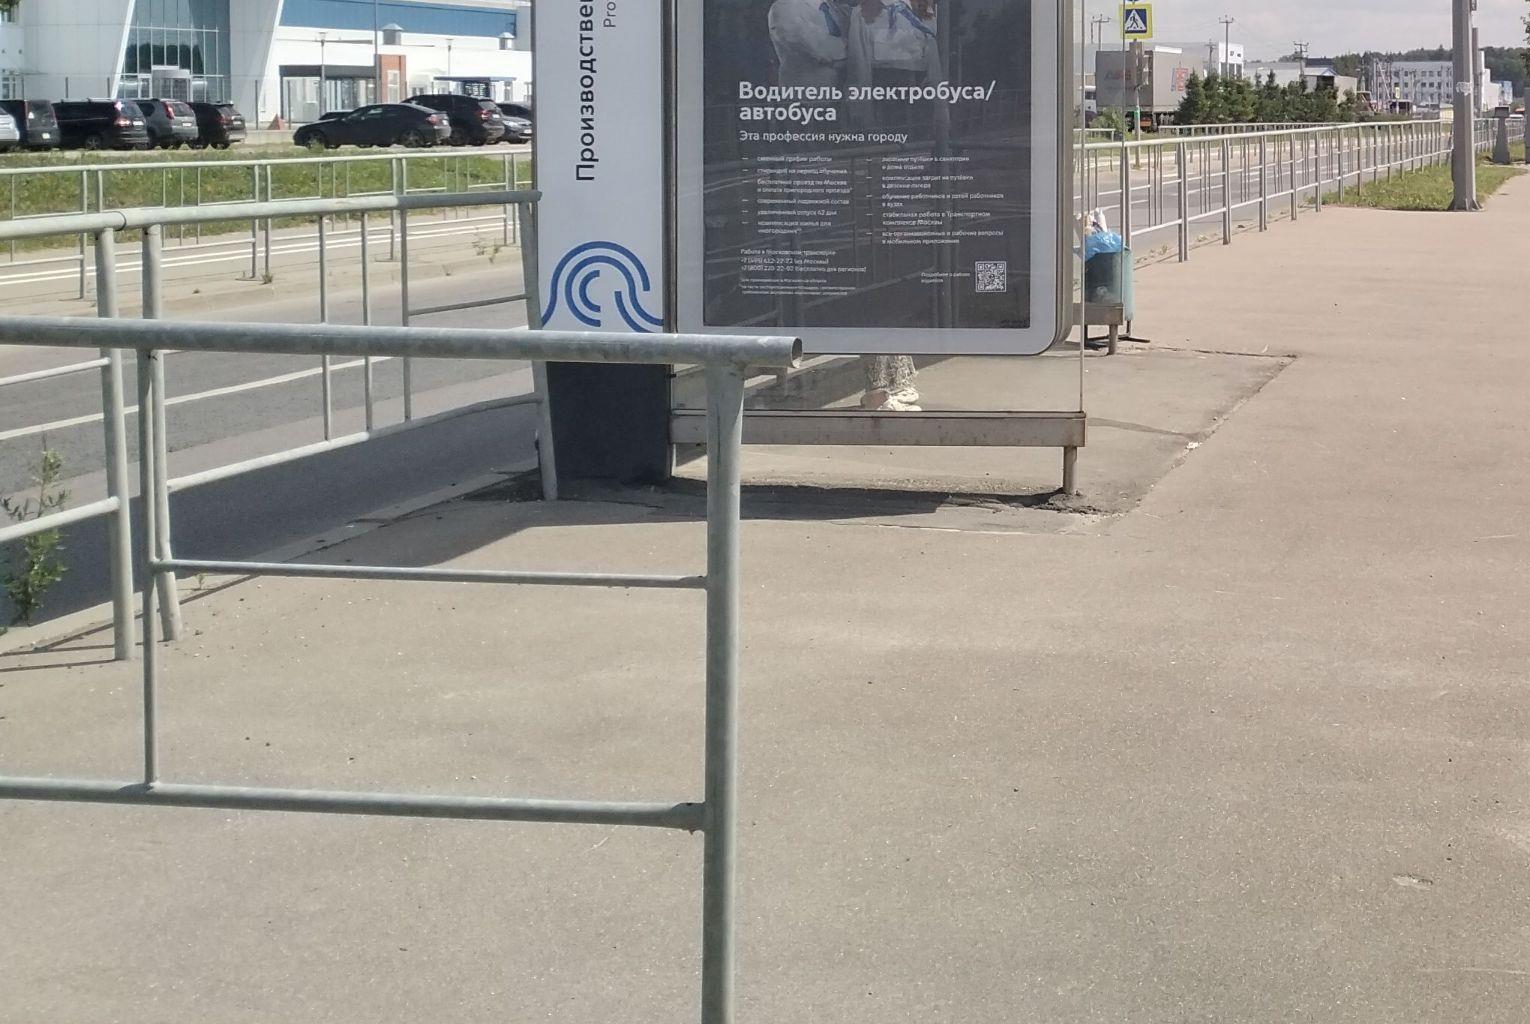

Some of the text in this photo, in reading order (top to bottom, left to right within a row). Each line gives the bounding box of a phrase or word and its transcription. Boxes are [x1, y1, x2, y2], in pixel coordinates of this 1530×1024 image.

[738, 80, 997, 104] Водитель электробуса/
[739, 103, 837, 124] автобуса
[739, 130, 909, 144] Эта профессия нужна городу
